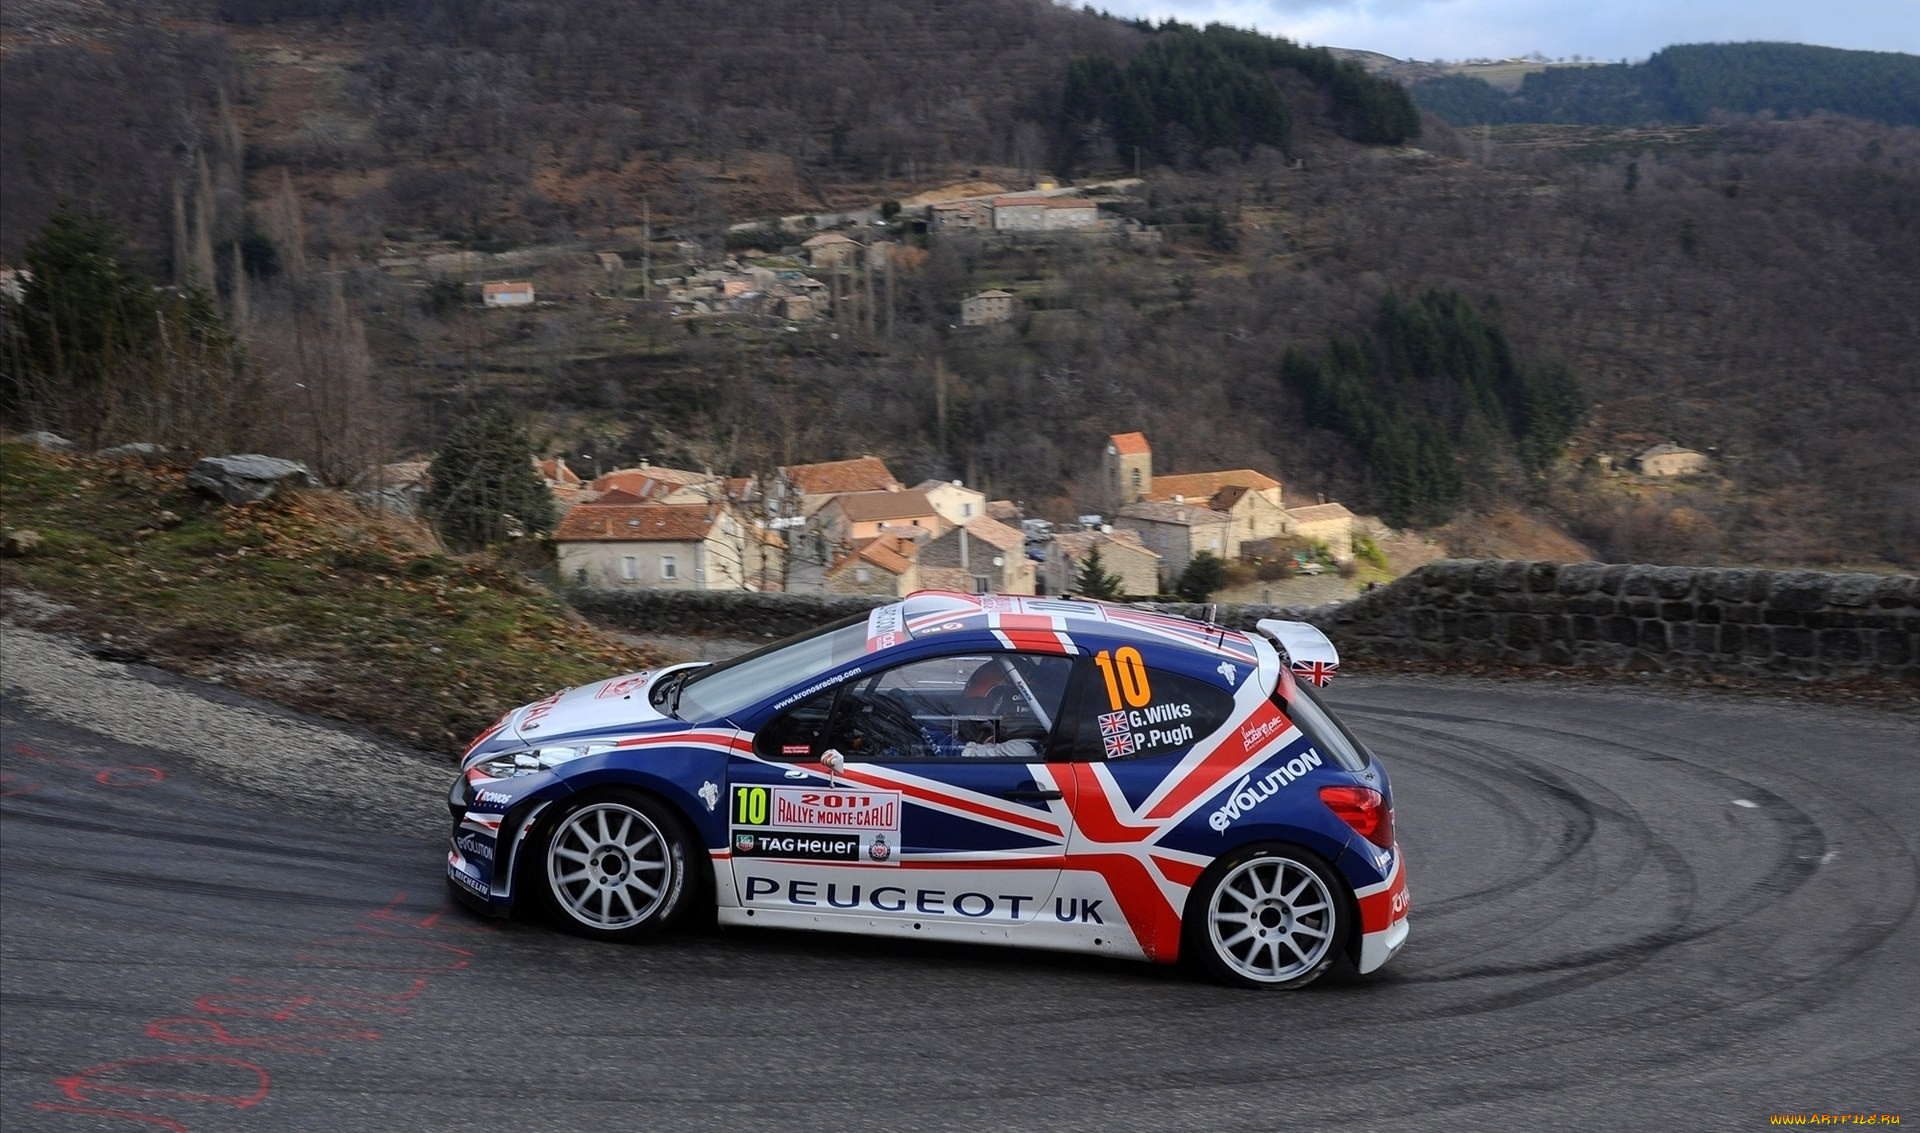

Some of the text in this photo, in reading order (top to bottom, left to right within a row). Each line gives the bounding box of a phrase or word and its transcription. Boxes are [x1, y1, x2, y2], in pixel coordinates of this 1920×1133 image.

[773, 666, 862, 711] www.kronosracing.com
[1094, 646, 1151, 711] 10
[1129, 703, 1192, 728] G.Wilks
[1133, 723, 1193, 750] P.Pugh
[737, 786, 766, 825] 10
[778, 796, 894, 827] RALLYE MONTE-CARLO
[801, 794, 871, 808] 2011
[454, 870, 489, 895] MICHELIN
[745, 876, 1033, 919] PEUGEOT
[1055, 897, 1105, 925] UK
